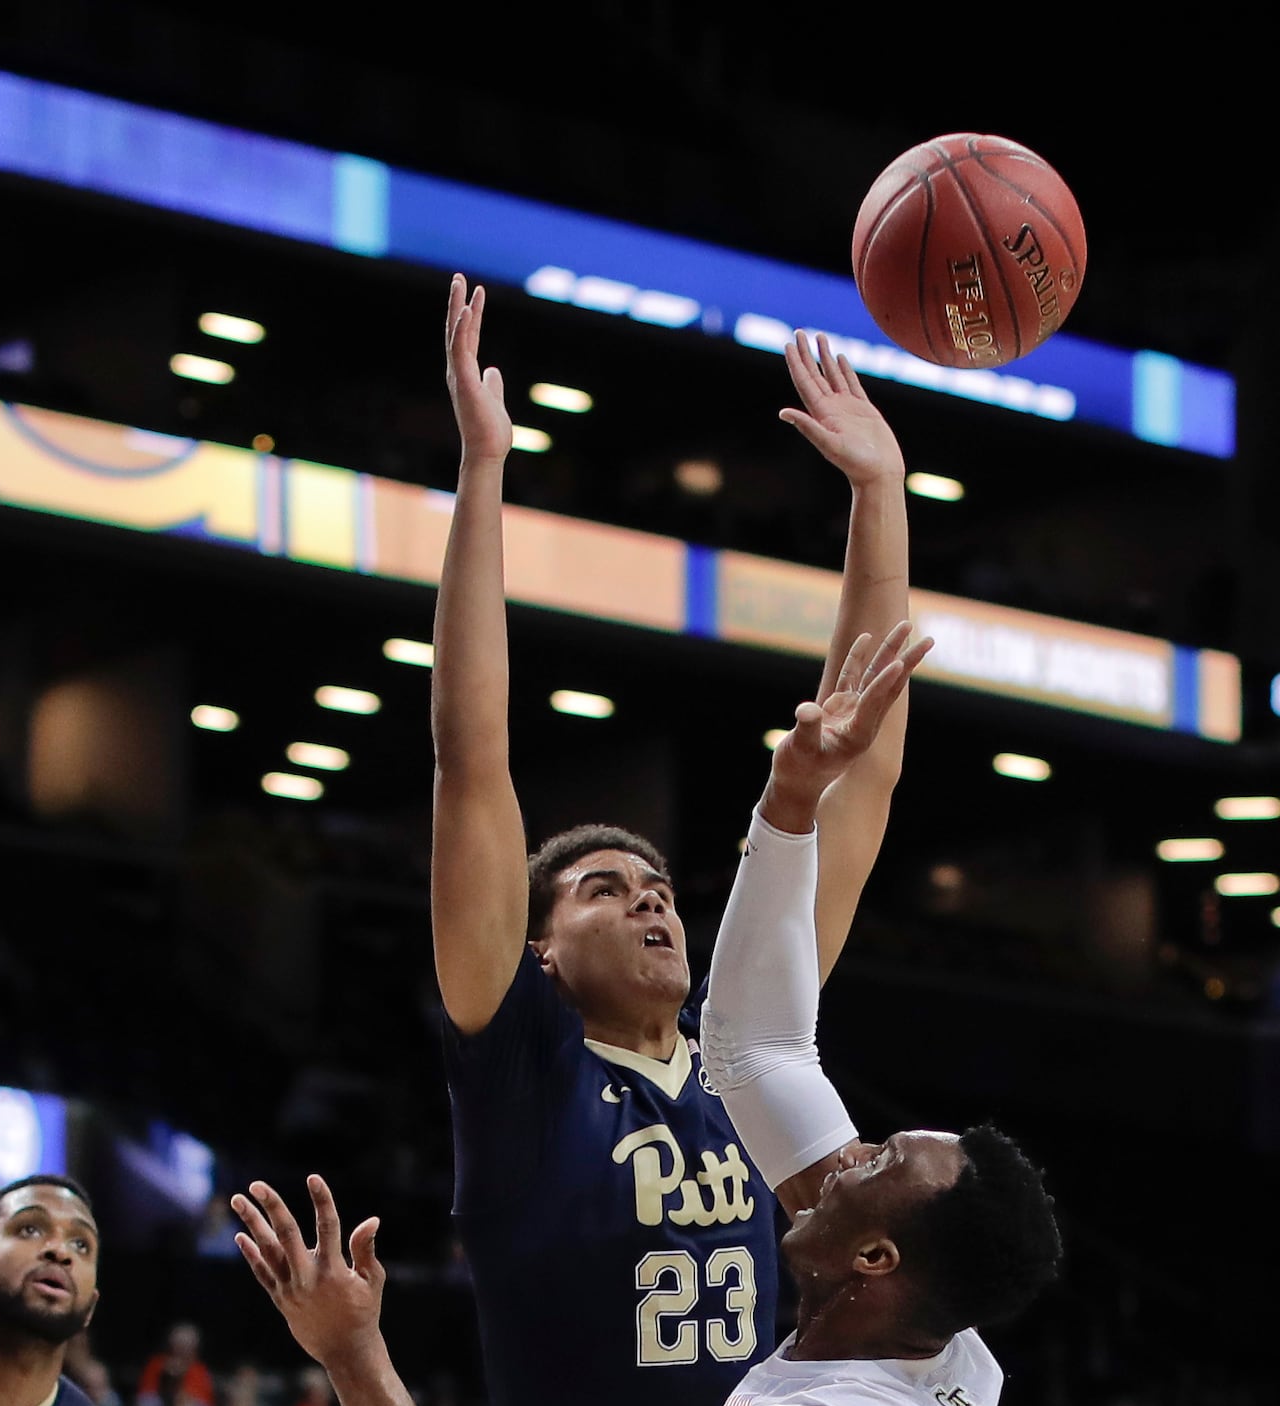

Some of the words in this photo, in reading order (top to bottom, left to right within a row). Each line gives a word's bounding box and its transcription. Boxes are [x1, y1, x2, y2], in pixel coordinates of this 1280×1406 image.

[1002, 222, 1061, 342] SPALD
[612, 1123, 754, 1226] Pitt
[635, 1246, 757, 1367] 23
